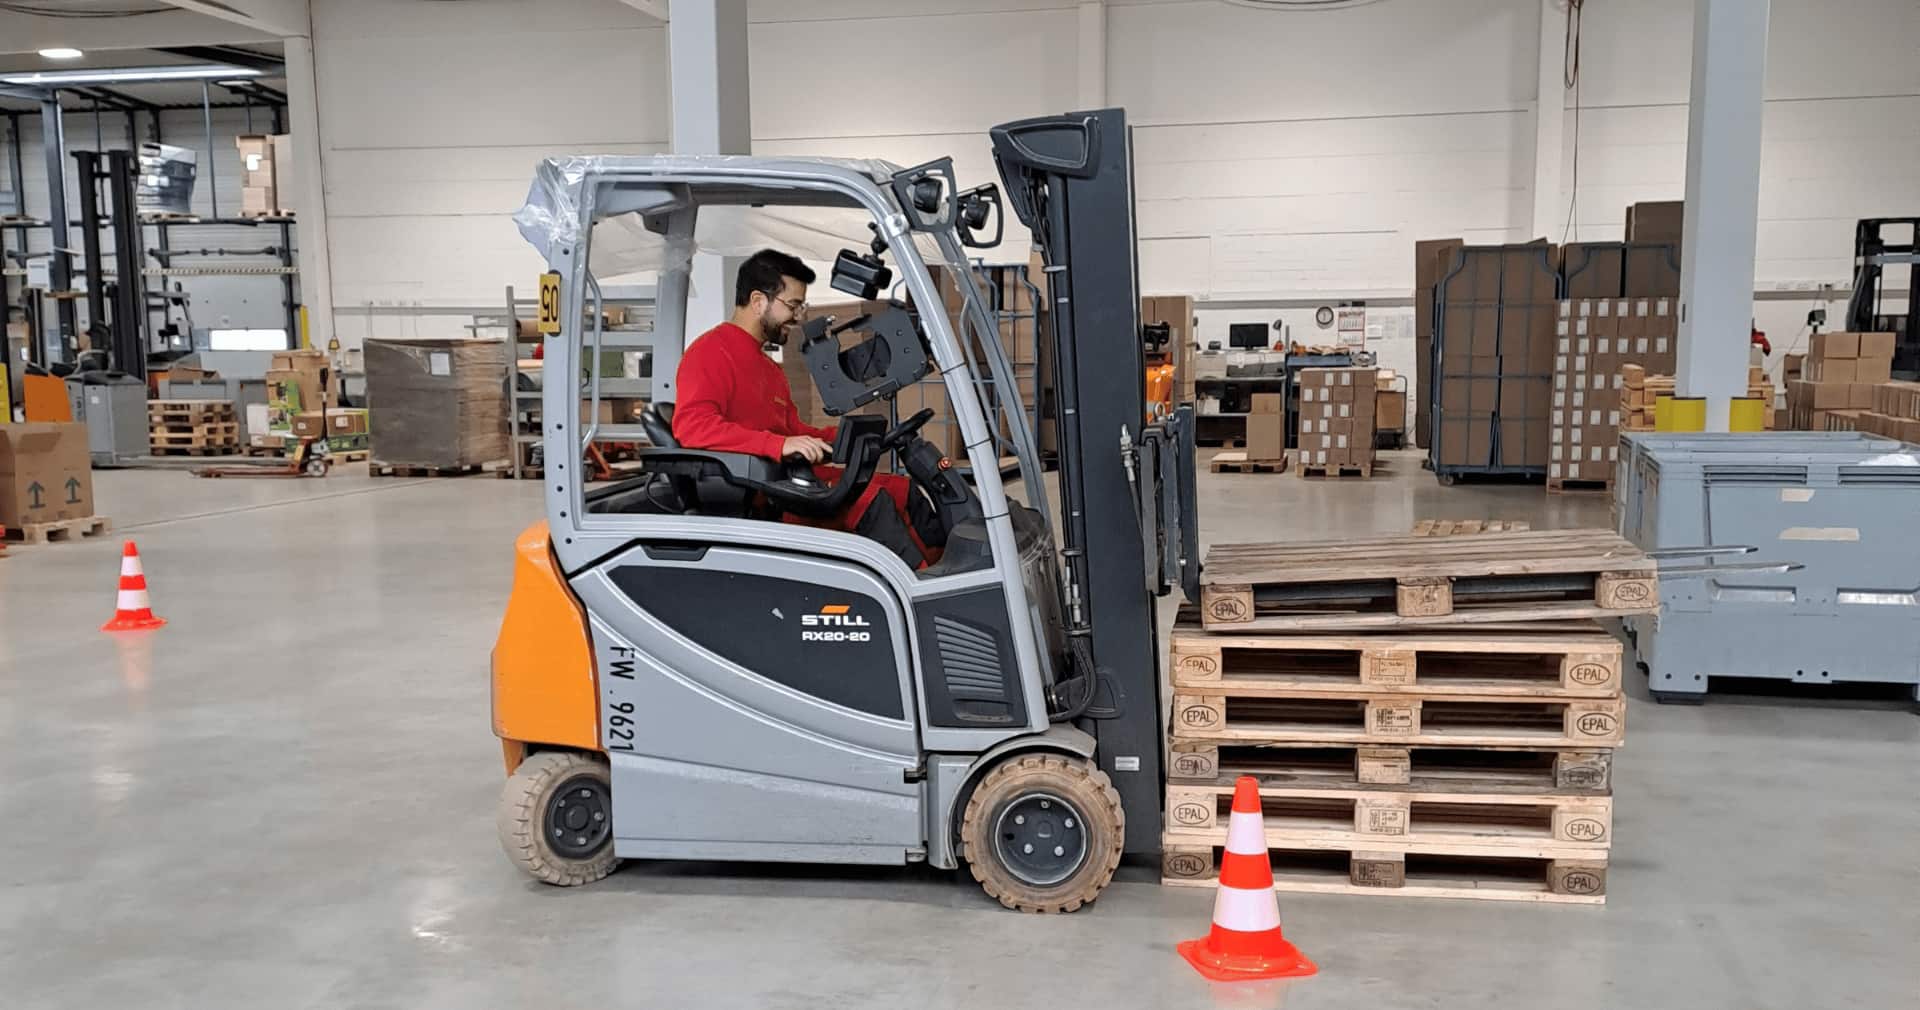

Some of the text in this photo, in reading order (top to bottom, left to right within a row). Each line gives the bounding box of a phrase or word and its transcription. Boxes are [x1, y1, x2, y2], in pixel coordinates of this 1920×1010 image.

[1215, 602, 1240, 617] EPAL
[801, 615, 870, 626] STILL
[802, 631, 871, 642] RX20-20
[609, 646, 635, 680] FW
[1576, 667, 1604, 681] EPAL
[1186, 710, 1213, 723] EPAL
[609, 702, 635, 751] 9621
[1582, 718, 1611, 731] EPAL
[1178, 807, 1204, 820] EPAL
[1570, 823, 1600, 837] EPAL
[1174, 860, 1199, 872] EPAL
[1566, 876, 1594, 890] EPAL
